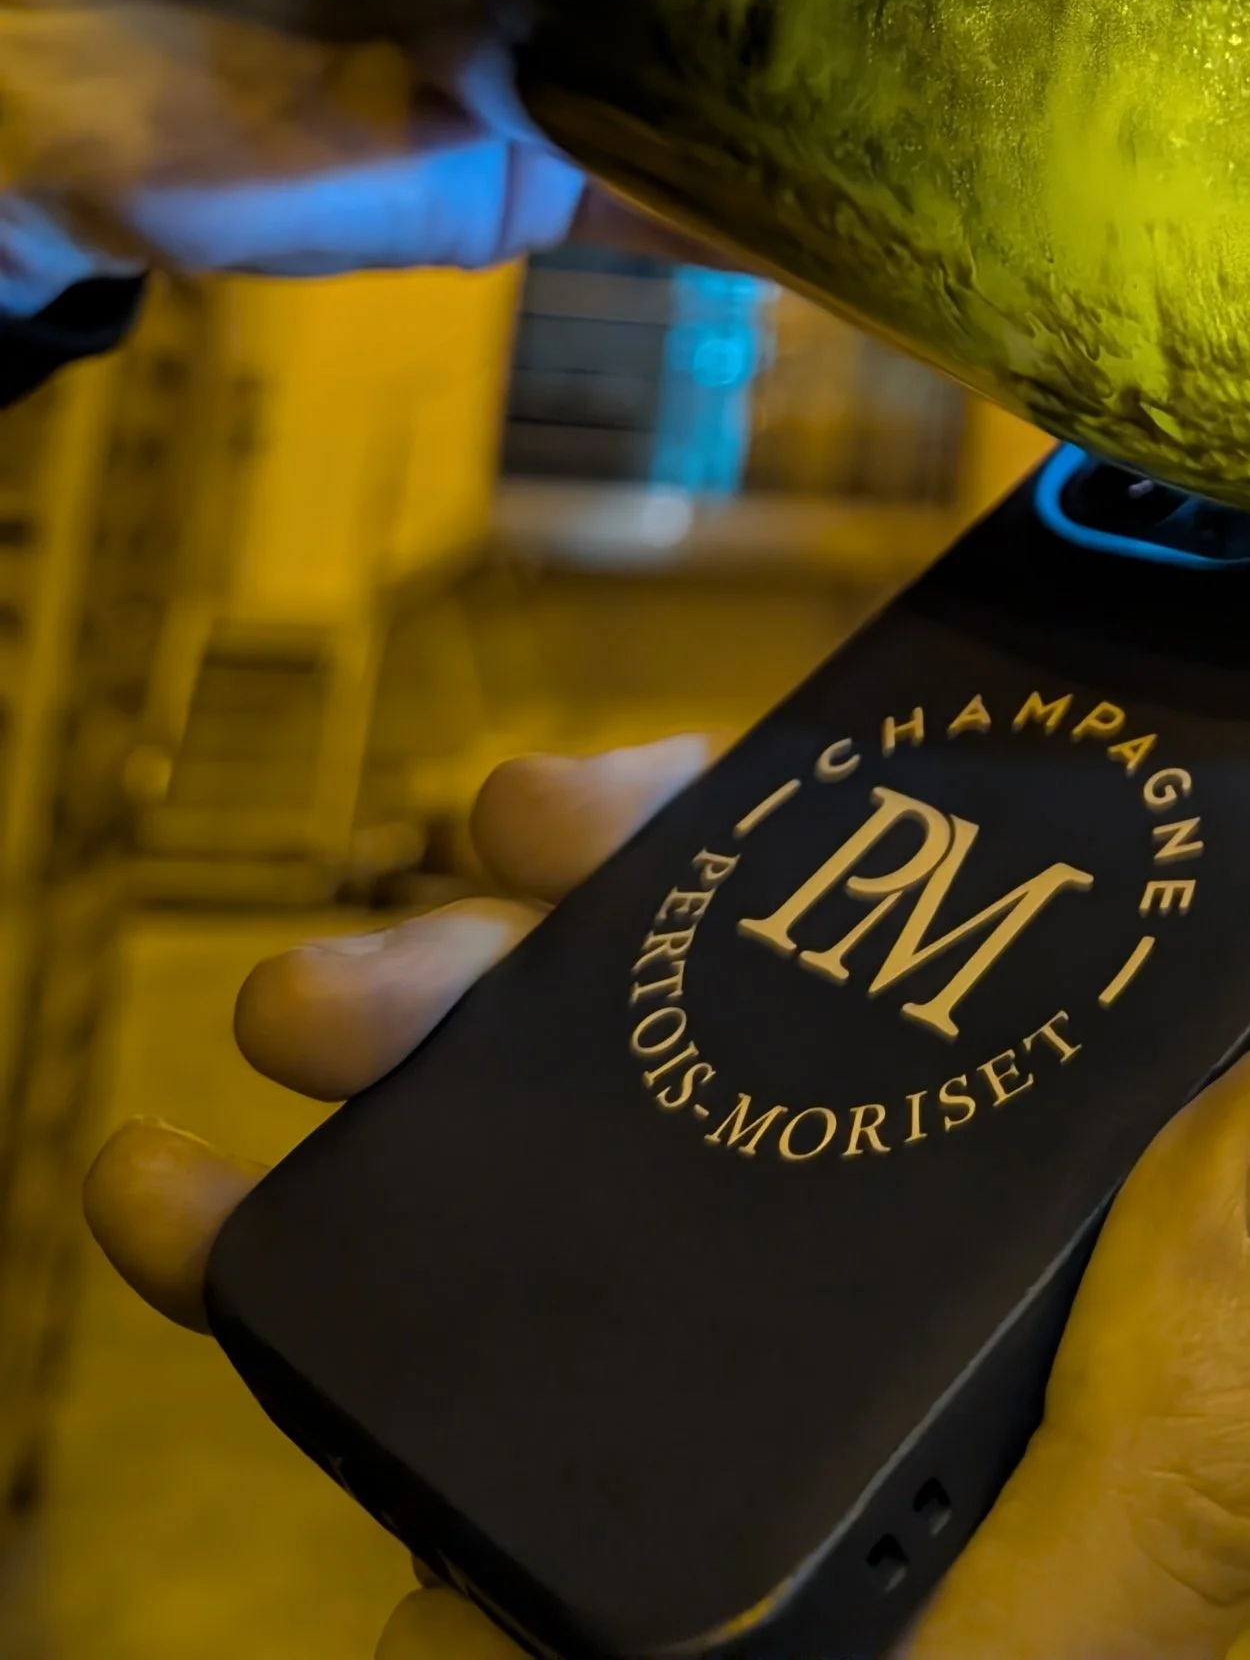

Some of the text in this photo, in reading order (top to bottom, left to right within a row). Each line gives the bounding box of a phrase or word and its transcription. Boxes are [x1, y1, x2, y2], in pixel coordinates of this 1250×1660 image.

[738, 786, 1094, 1041] PM
[815, 691, 1203, 918] CHAMPAGNE
[629, 847, 1082, 1161] PERTOIS-MORISET
